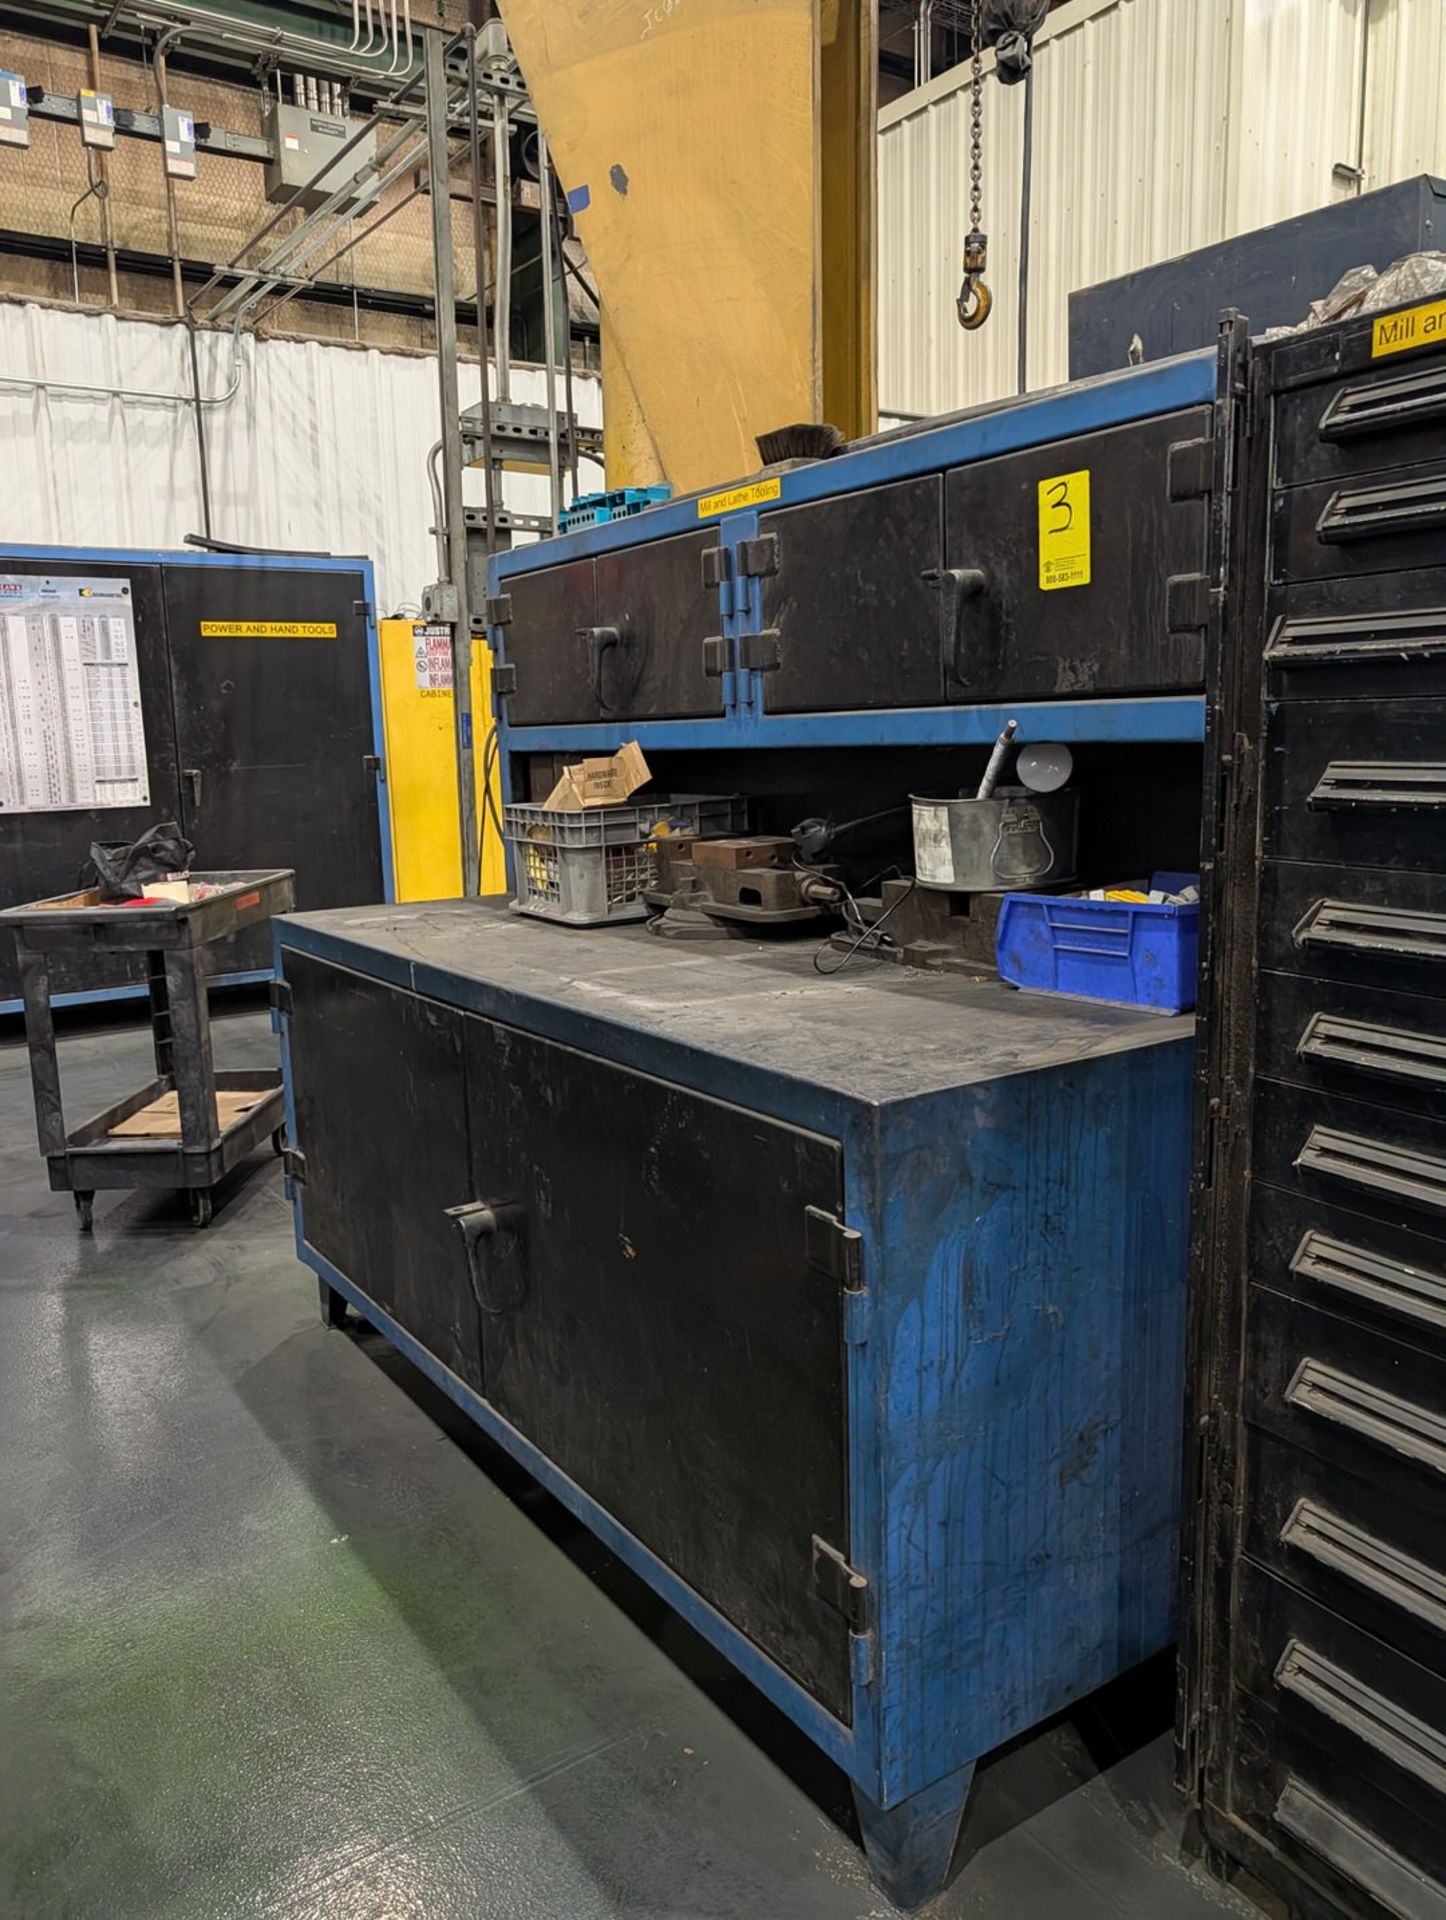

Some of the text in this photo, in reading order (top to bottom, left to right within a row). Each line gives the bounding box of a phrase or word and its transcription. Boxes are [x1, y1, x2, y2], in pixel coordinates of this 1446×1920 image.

[1379, 316, 1415, 346] Mill
[700, 484, 778, 513] Mill and Lathe Tooling
[1046, 481, 1073, 535] 3
[202, 623, 336, 635] POWER AND HAND TOOLS
